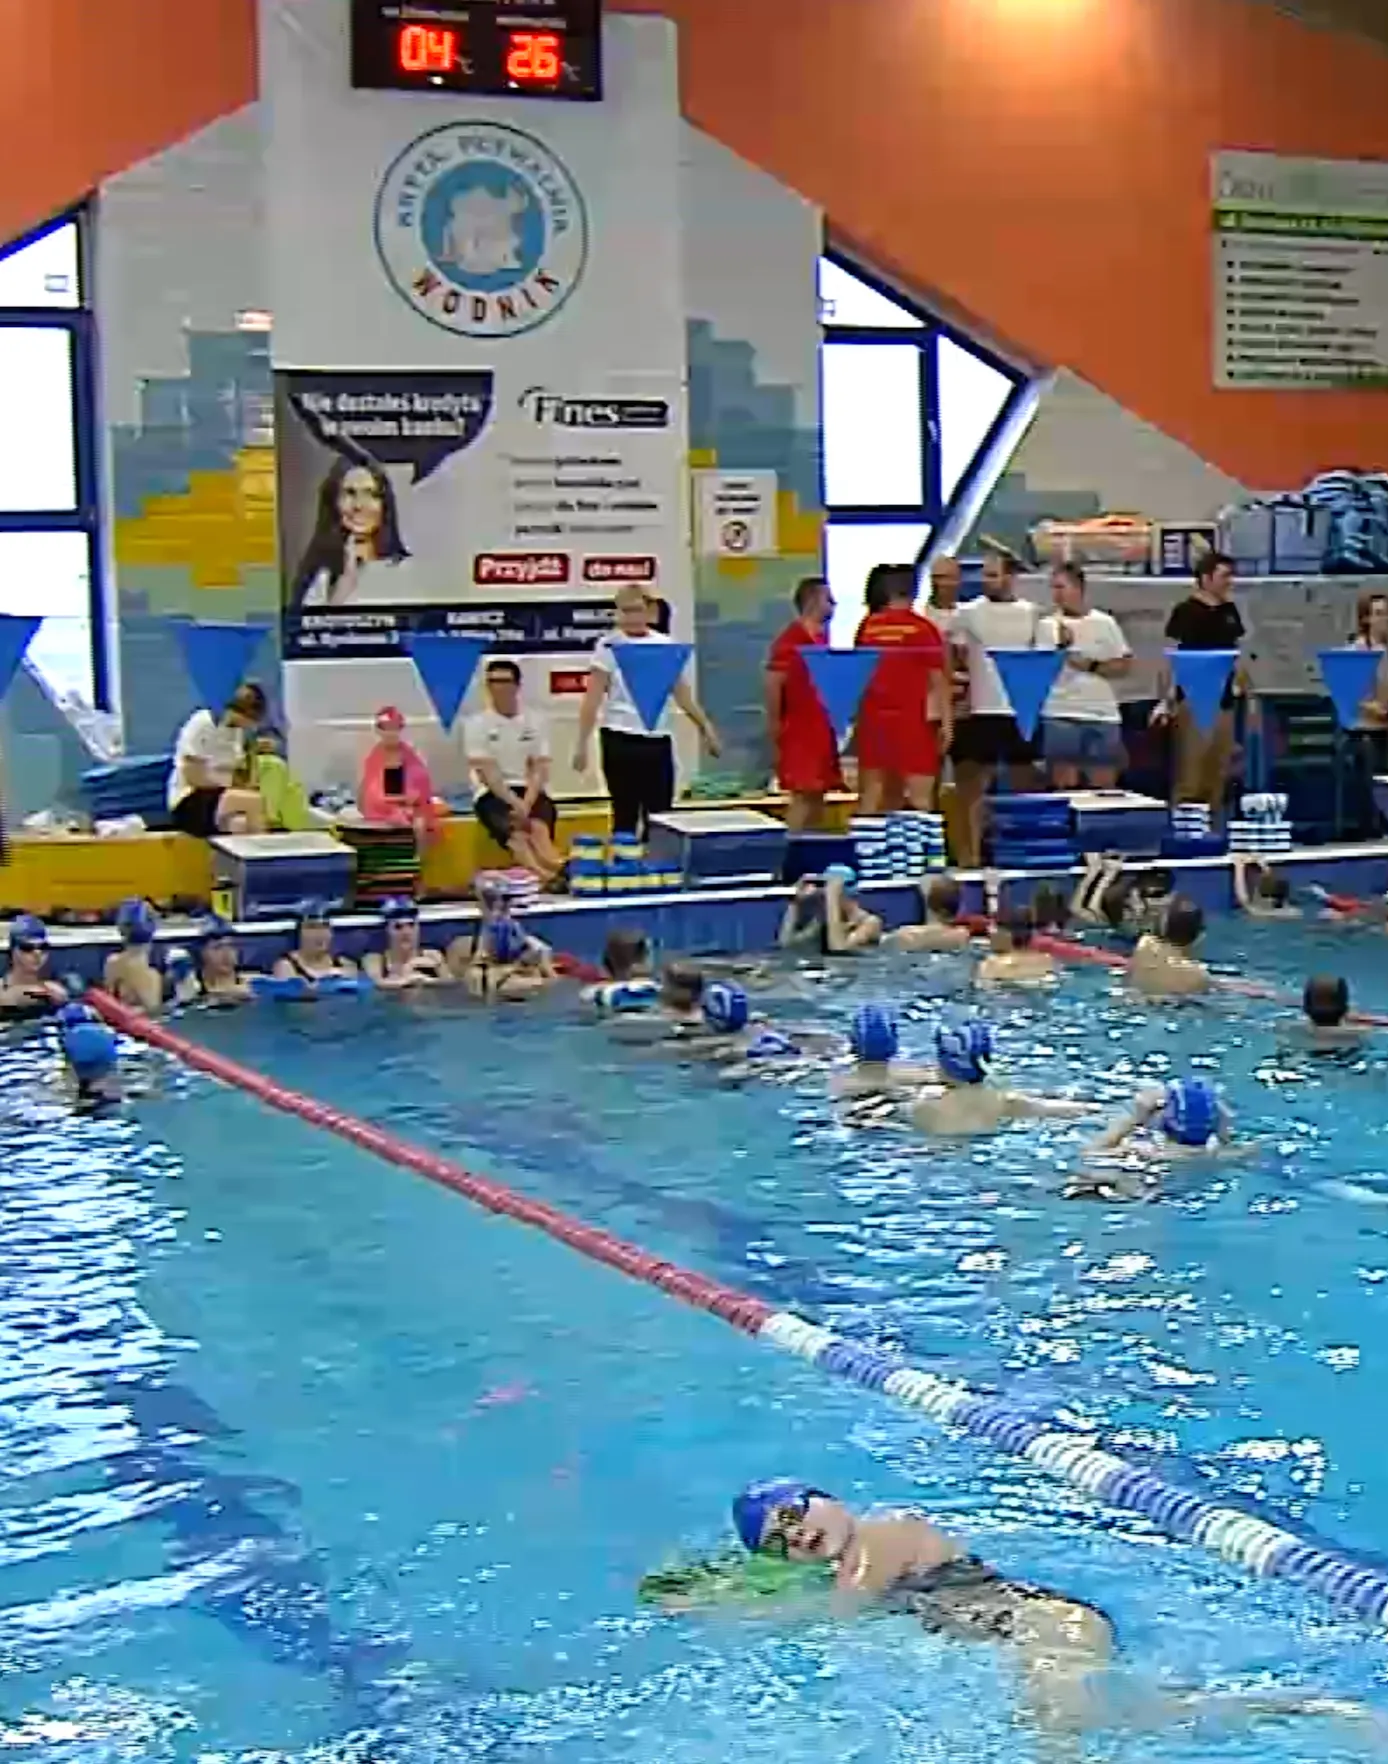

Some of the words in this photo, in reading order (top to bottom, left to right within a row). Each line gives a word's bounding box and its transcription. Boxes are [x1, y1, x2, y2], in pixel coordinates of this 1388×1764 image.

[400, 25, 454, 71] 04
[507, 33, 559, 78] 26
[412, 267, 559, 321] WODNIK
